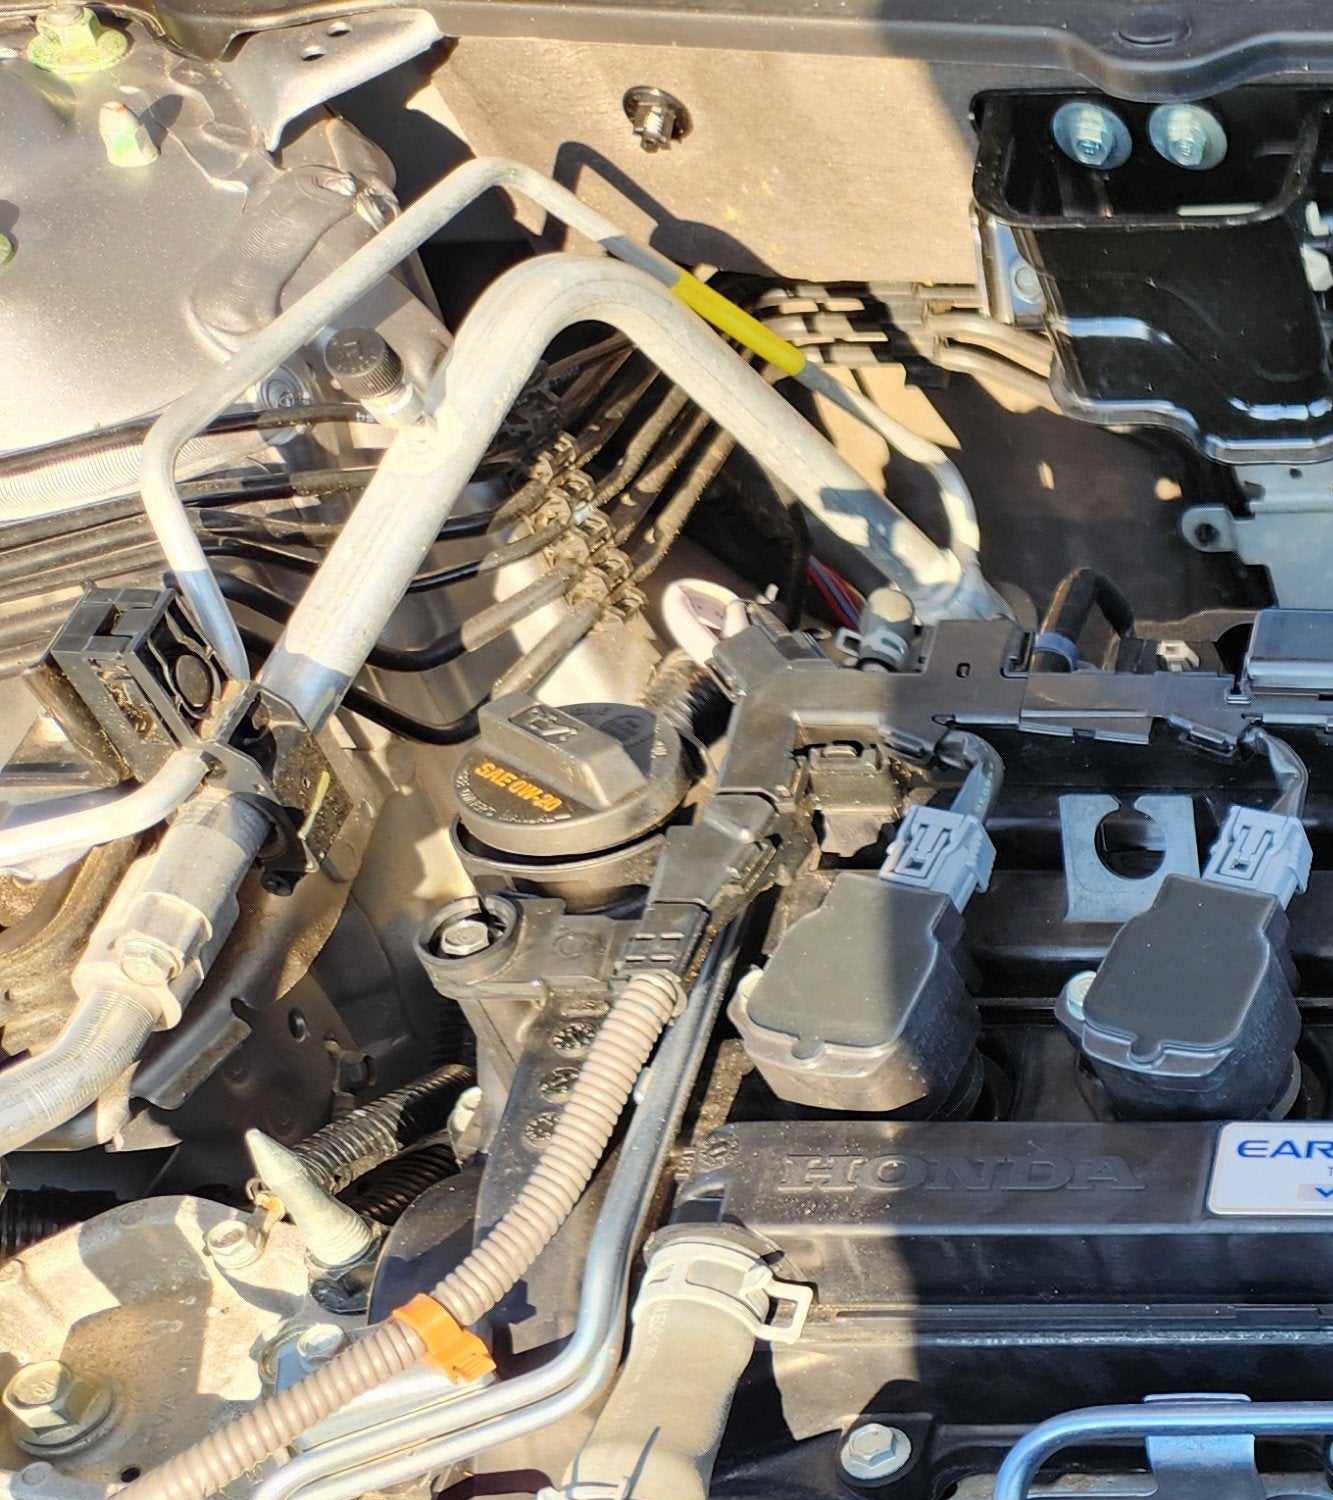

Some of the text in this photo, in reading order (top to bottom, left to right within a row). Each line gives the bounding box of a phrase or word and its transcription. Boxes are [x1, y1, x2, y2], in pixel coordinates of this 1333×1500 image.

[475, 762, 518, 789] SAE
[507, 780, 563, 812] 0W-20
[777, 1154, 1147, 1191] HONDA
